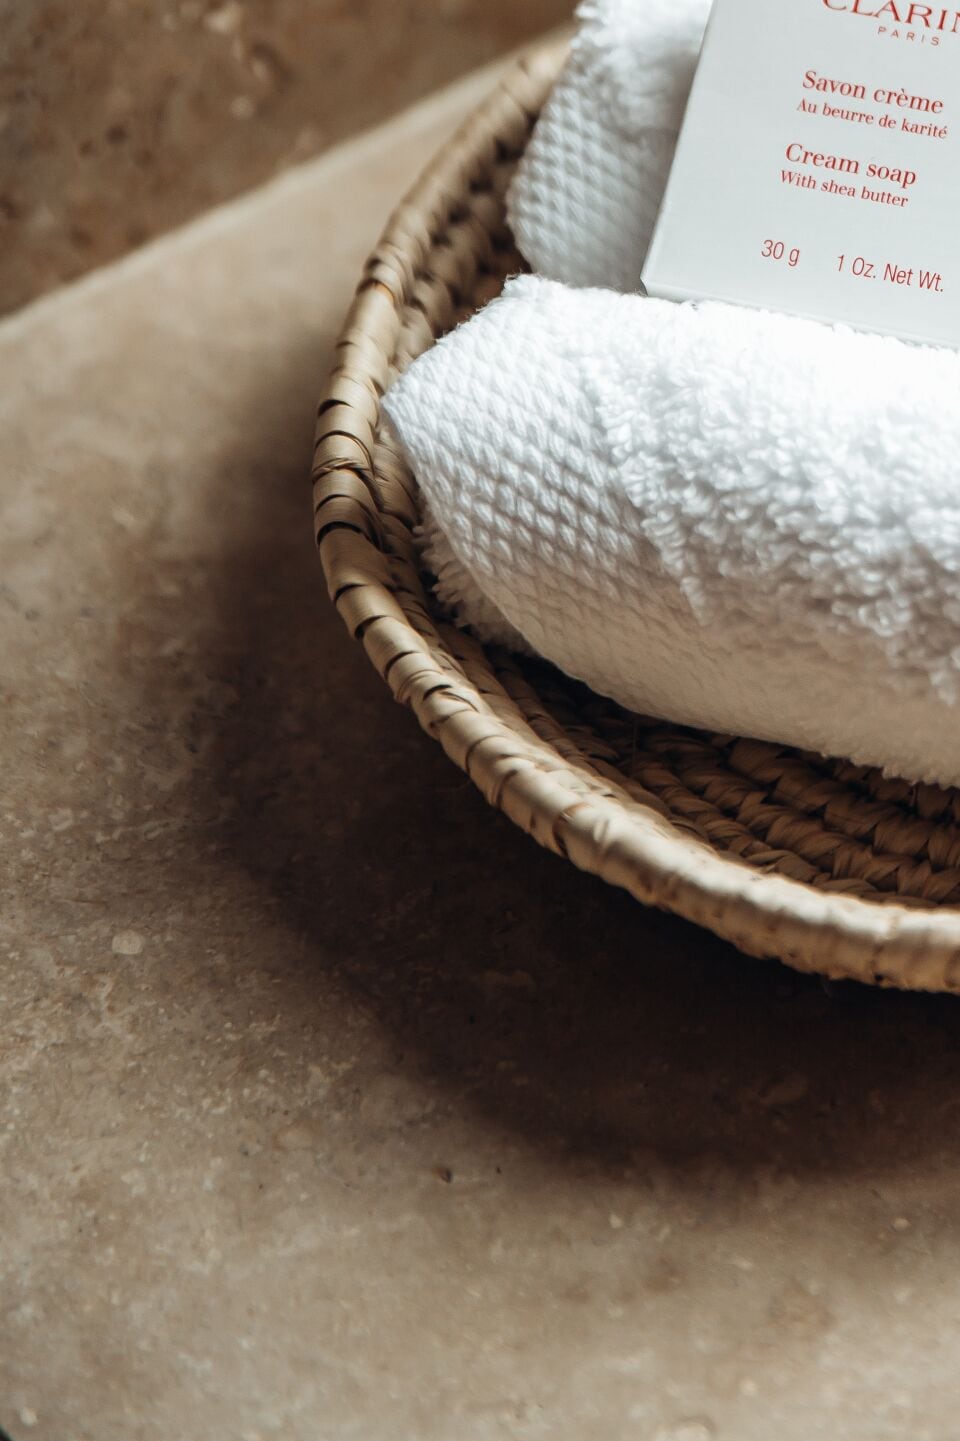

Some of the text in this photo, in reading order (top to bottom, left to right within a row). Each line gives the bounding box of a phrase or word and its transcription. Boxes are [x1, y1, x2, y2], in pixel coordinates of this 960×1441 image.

[877, 26, 940, 46] PARIS
[802, 70, 944, 114] Savon crème
[796, 97, 948, 140] Au beurre de karité
[785, 142, 917, 188] Cream soap
[780, 169, 909, 208] With shea butter
[761, 239, 944, 292] 30 g 1 Oz. Net Wt.
